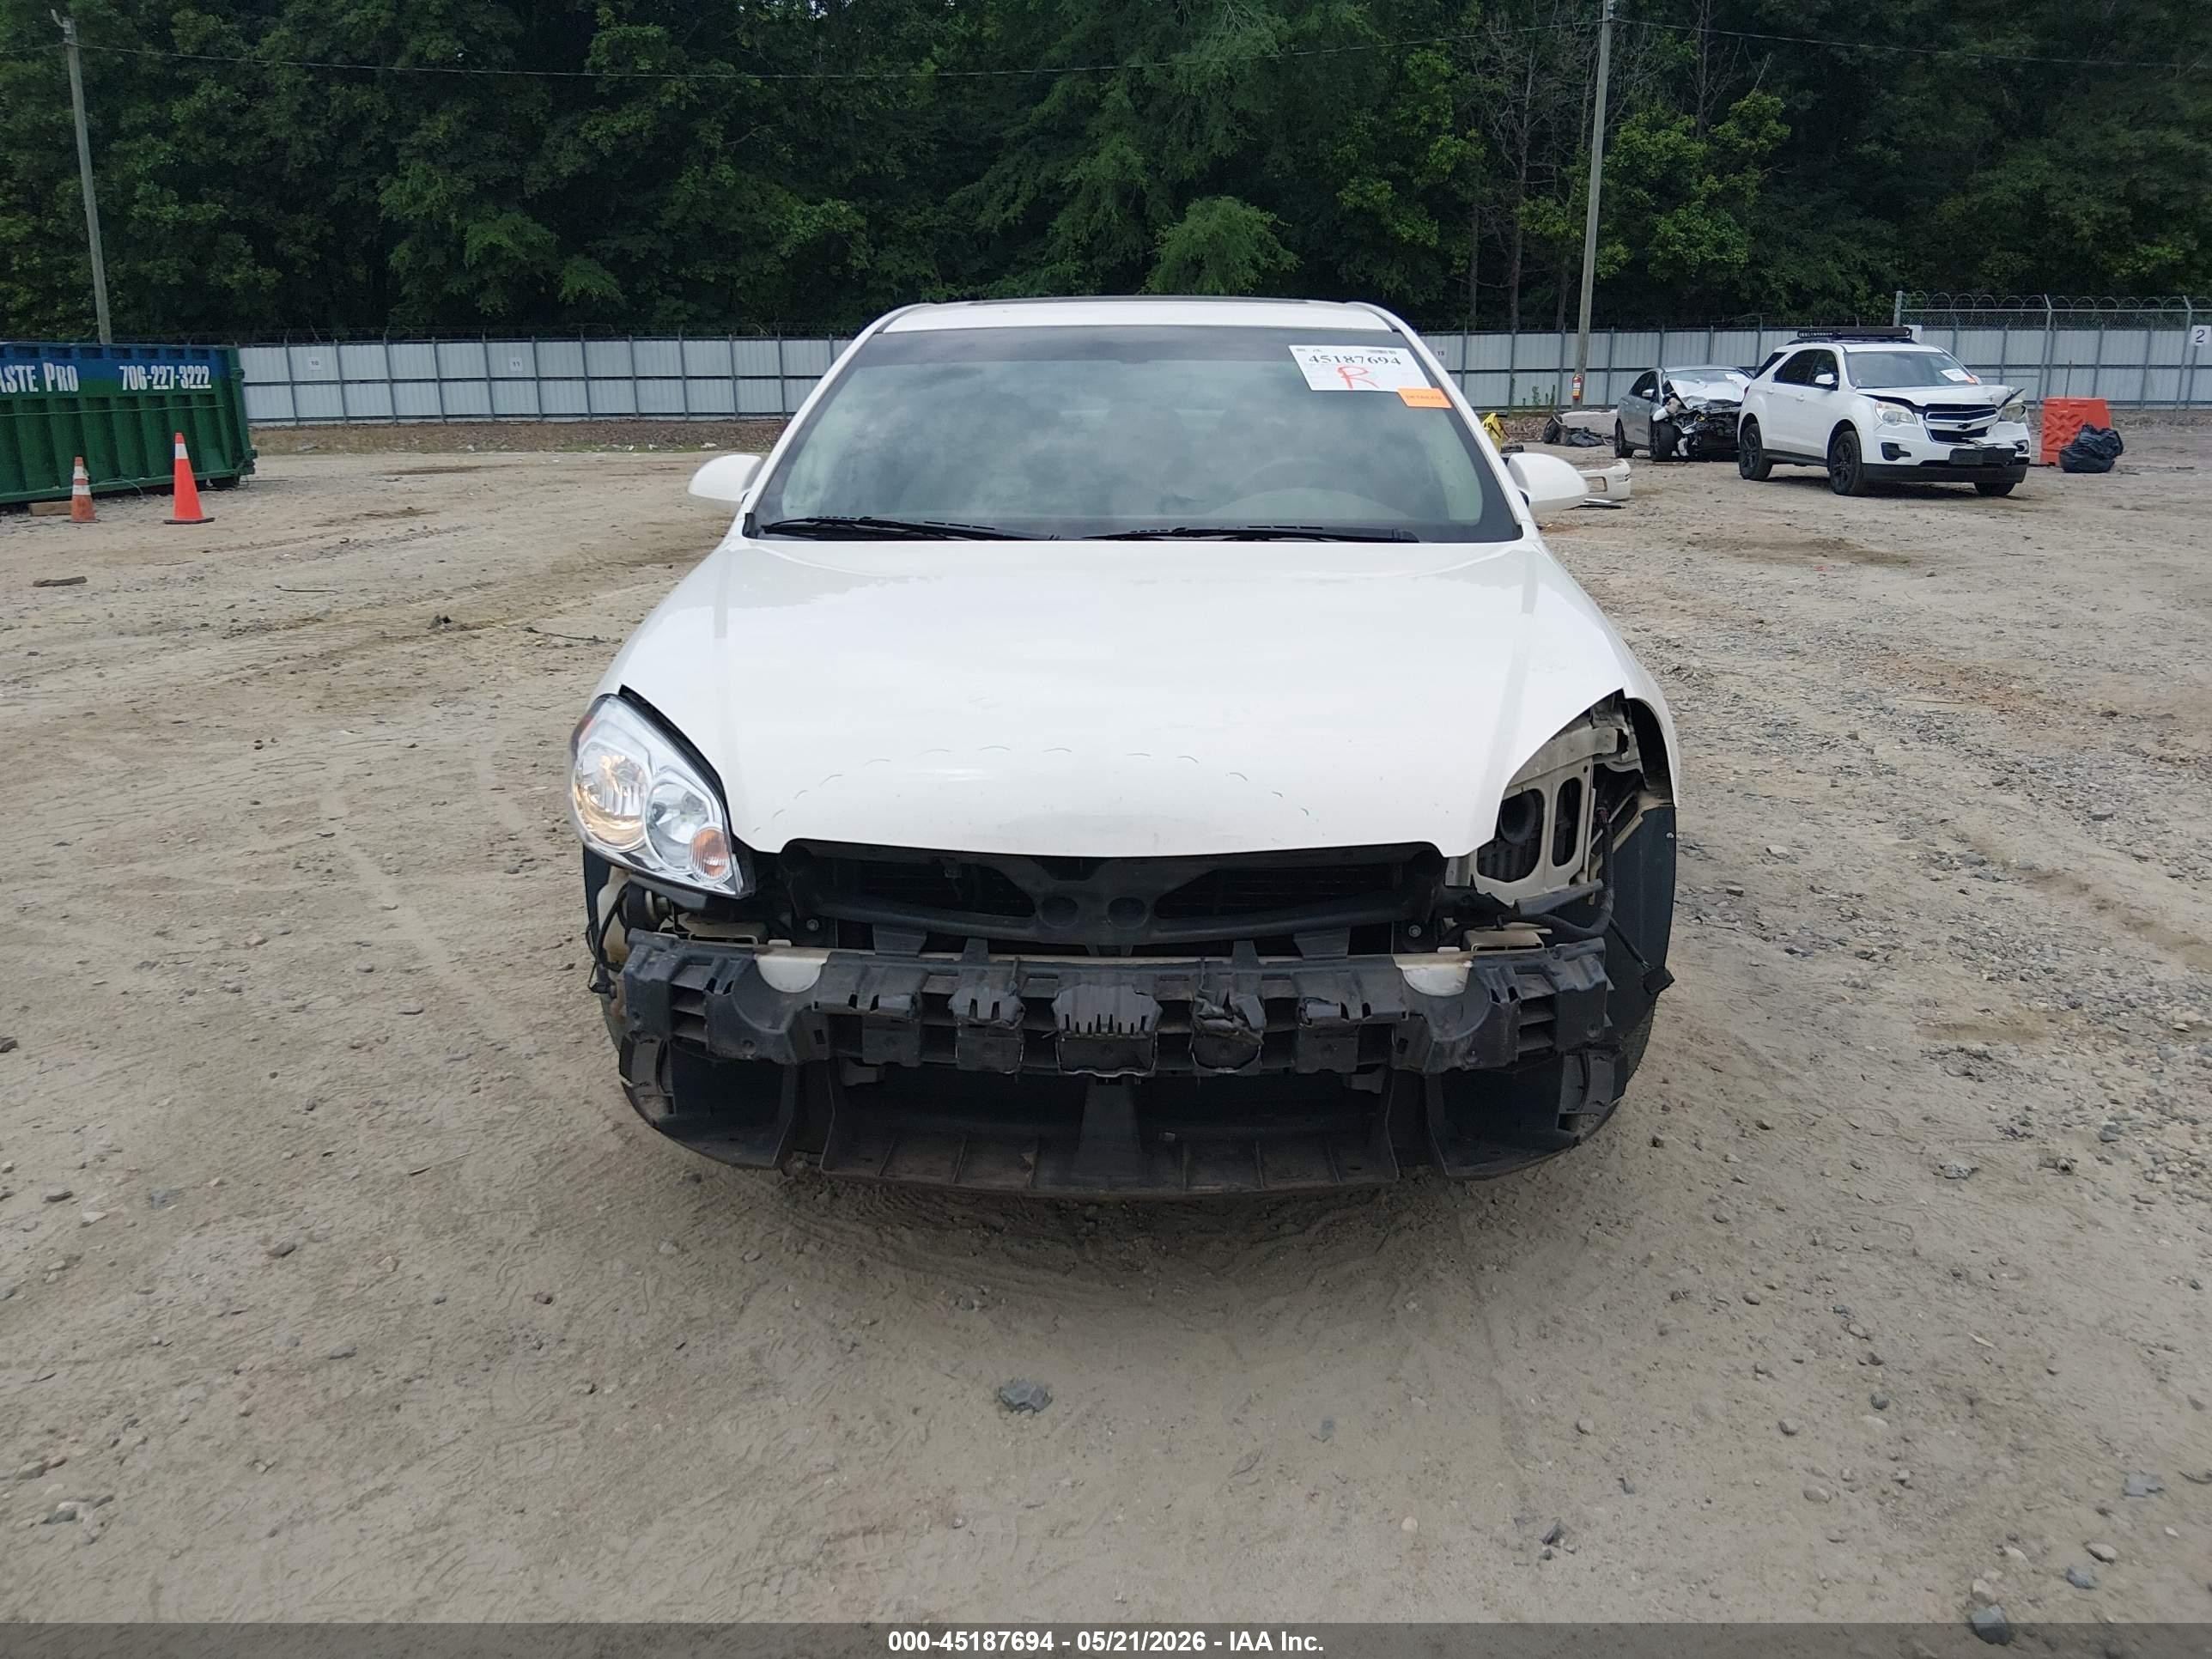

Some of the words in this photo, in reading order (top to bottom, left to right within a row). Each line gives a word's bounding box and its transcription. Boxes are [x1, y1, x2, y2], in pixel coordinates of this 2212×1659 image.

[2195, 329, 2205, 343] 2
[1309, 355, 1401, 365] 45187694
[42, 362, 79, 392] PRO
[118, 365, 212, 391] 706-227-3222
[1337, 366, 1380, 389] R
